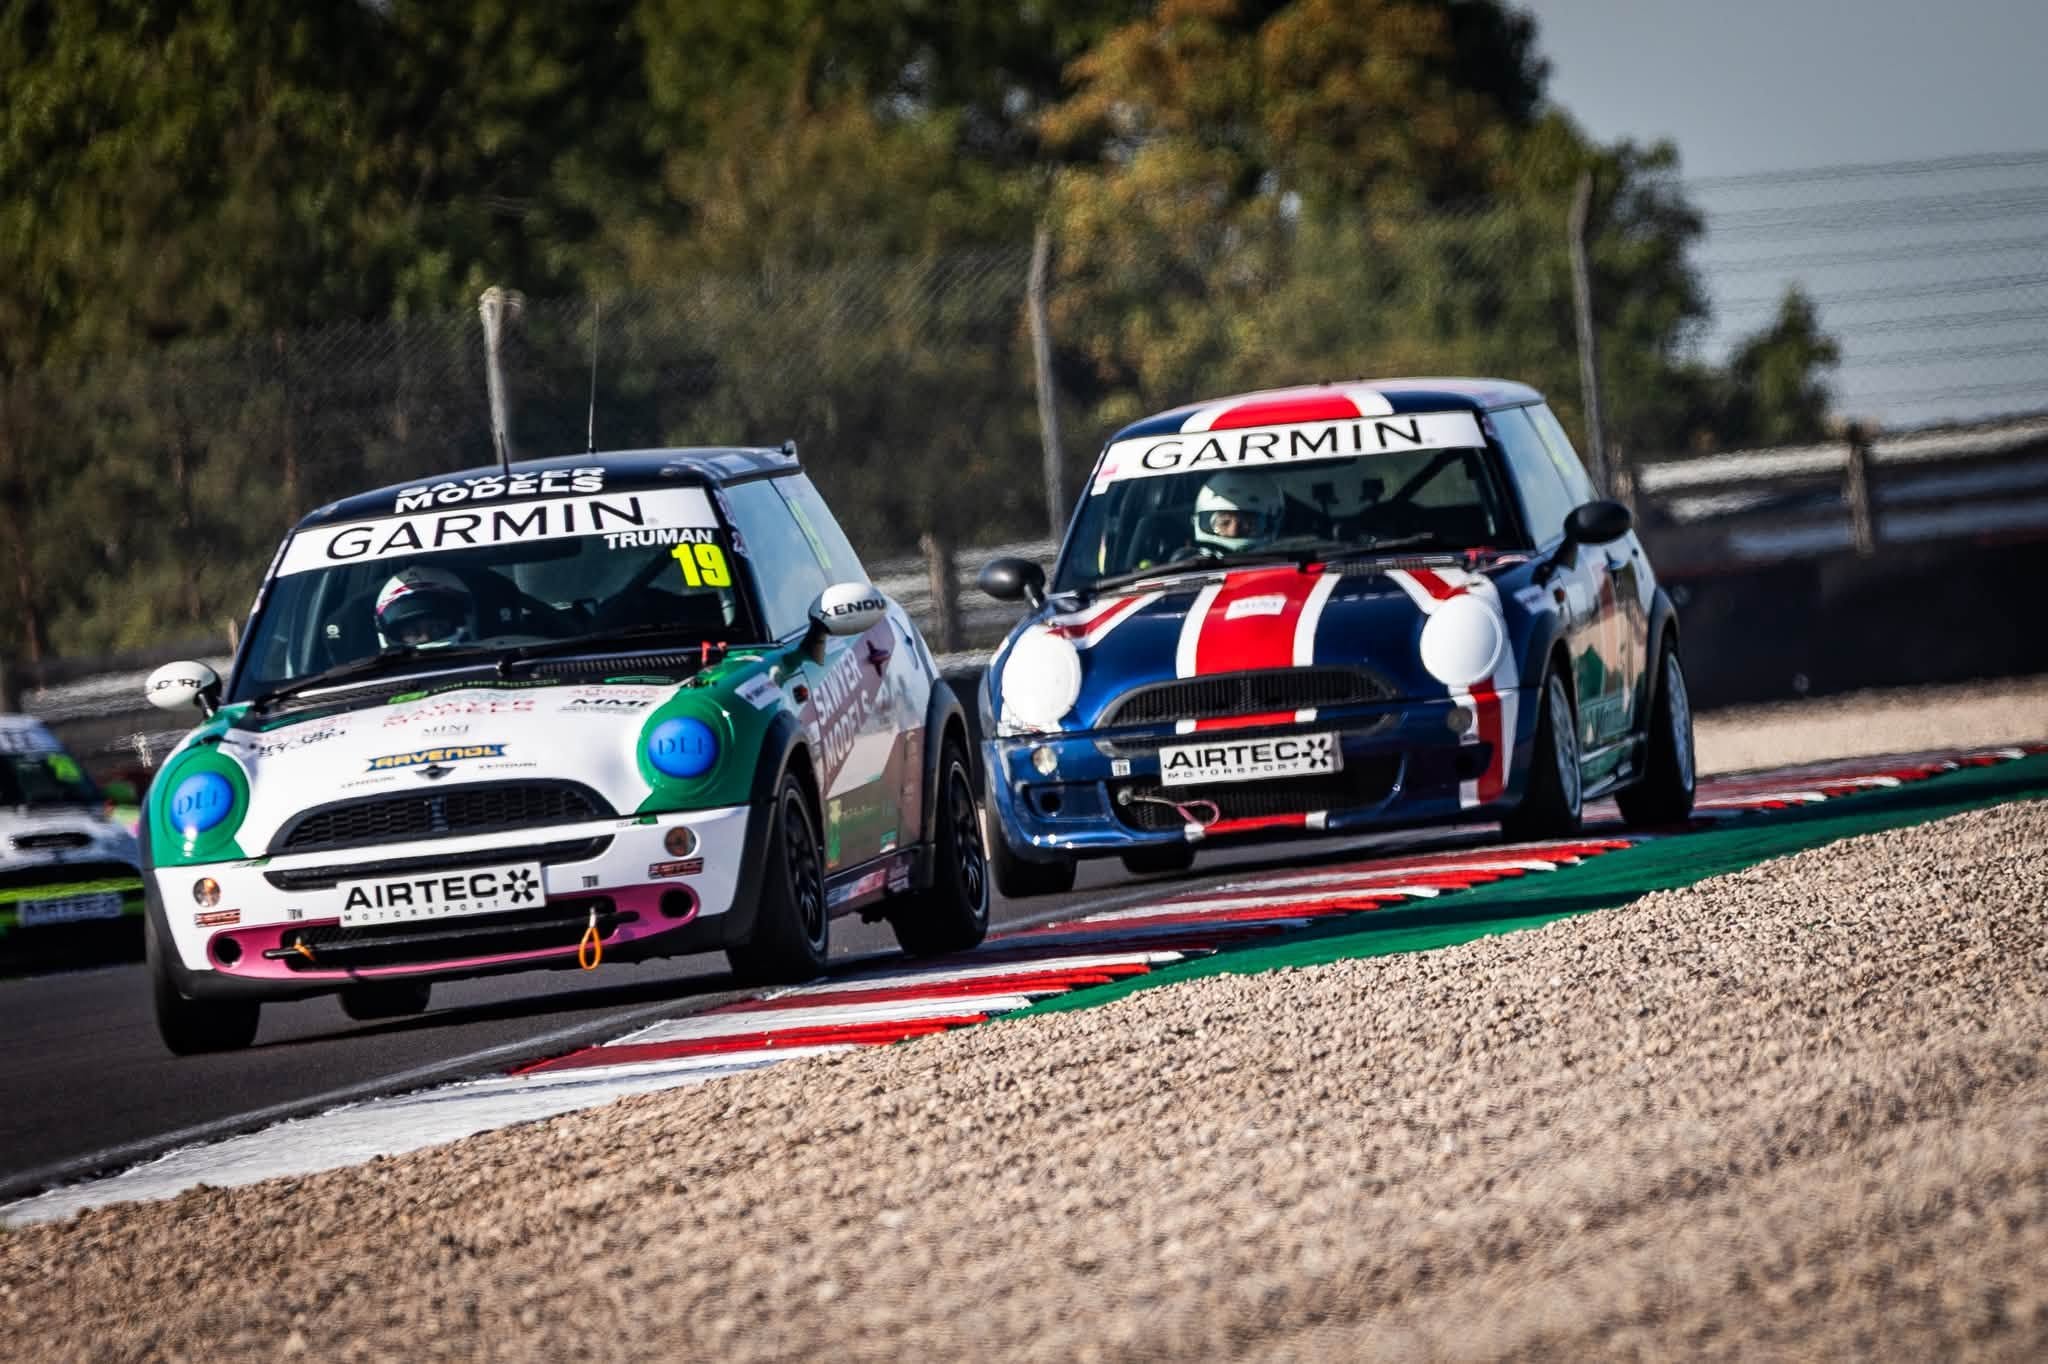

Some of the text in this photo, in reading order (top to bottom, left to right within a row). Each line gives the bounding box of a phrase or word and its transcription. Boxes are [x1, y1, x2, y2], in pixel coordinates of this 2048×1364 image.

[1142, 418, 1425, 471] GARMIN
[394, 475, 604, 514] MODELS
[326, 496, 645, 560] GARMIN
[603, 529, 713, 550] TRUMAN
[671, 543, 732, 587] 19
[813, 647, 864, 726] SAWYER
[374, 747, 499, 769] RAVENOL
[1164, 741, 1300, 771] AIRTEC
[1167, 762, 1300, 779] MOTORSPORT
[344, 873, 499, 911] AIRTEC
[344, 900, 500, 922] MOTORSPORT
